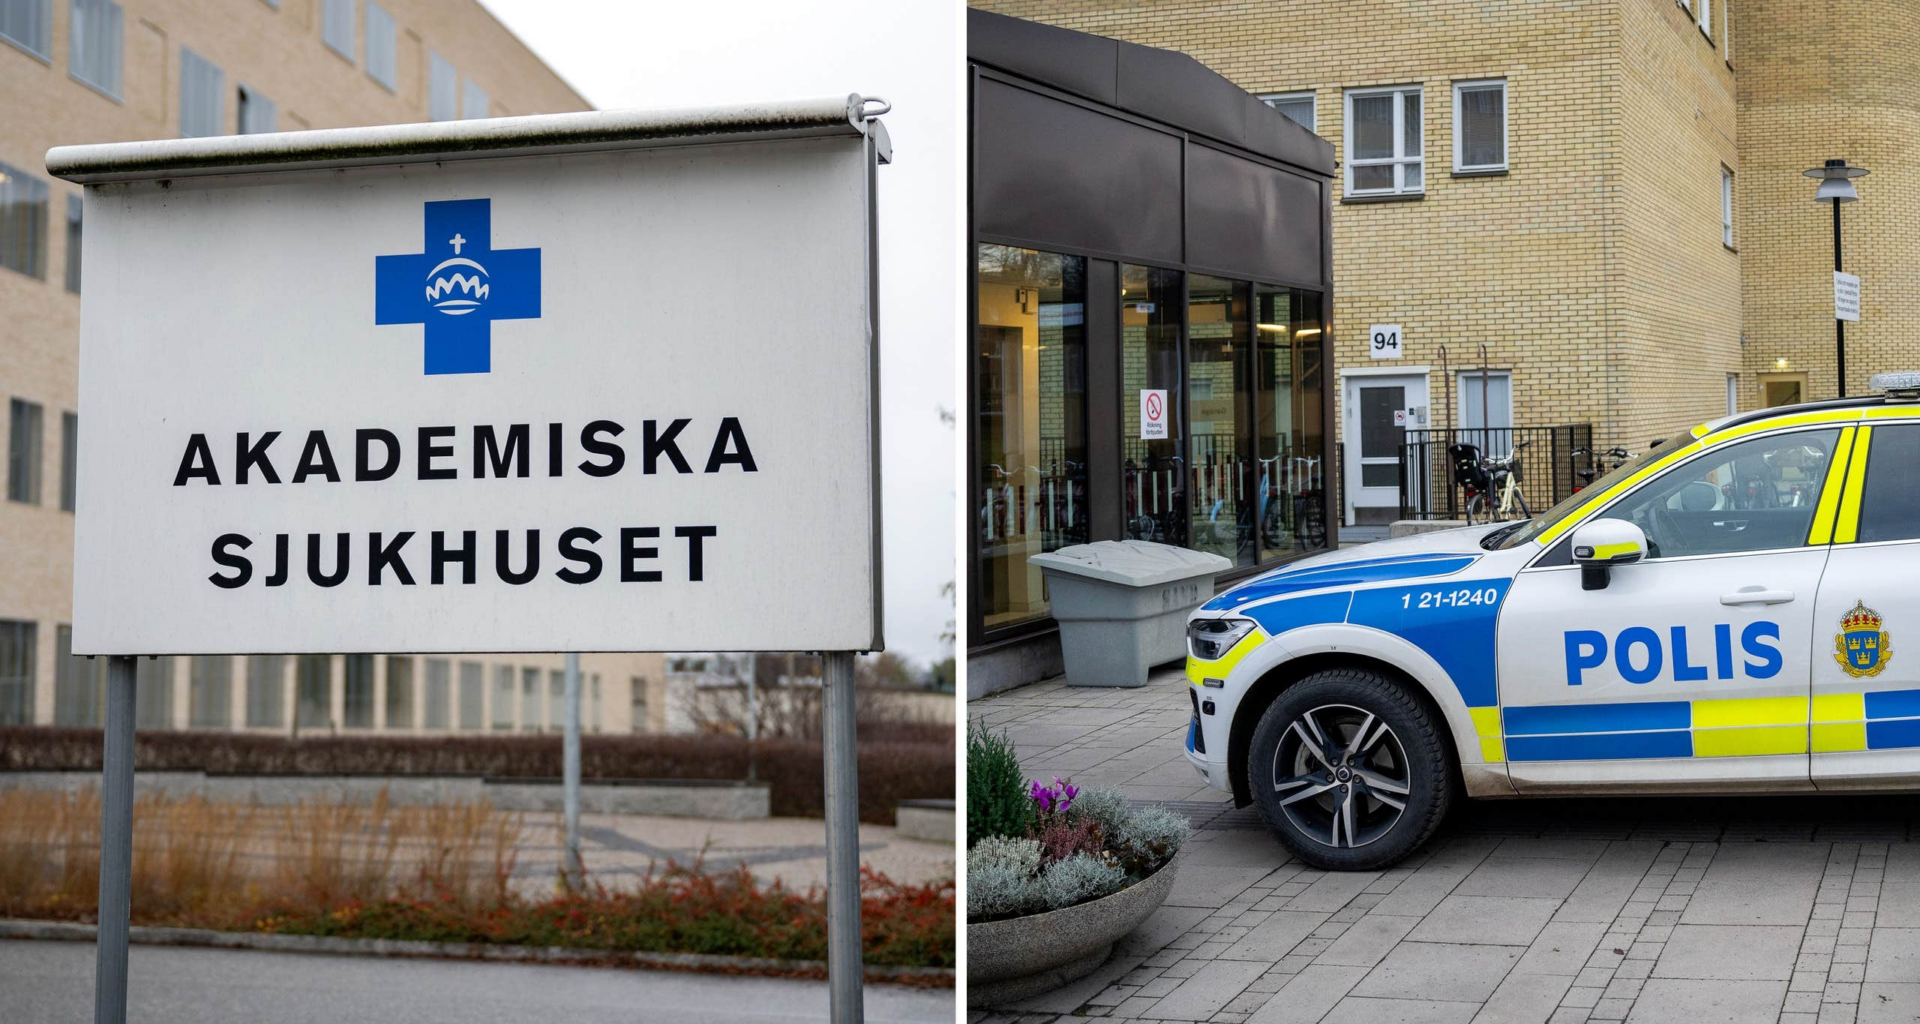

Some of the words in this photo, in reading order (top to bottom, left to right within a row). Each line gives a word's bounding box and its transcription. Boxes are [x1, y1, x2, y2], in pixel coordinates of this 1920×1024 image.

[1374, 332, 1398, 350] 94
[1146, 421, 1162, 429] Rökning
[173, 416, 758, 486] AKADEMISKA
[209, 526, 716, 588] SJUKHUSET
[1401, 593, 1411, 609] 1
[1418, 588, 1498, 609] 21-1240
[1564, 621, 1783, 685] POLIS
